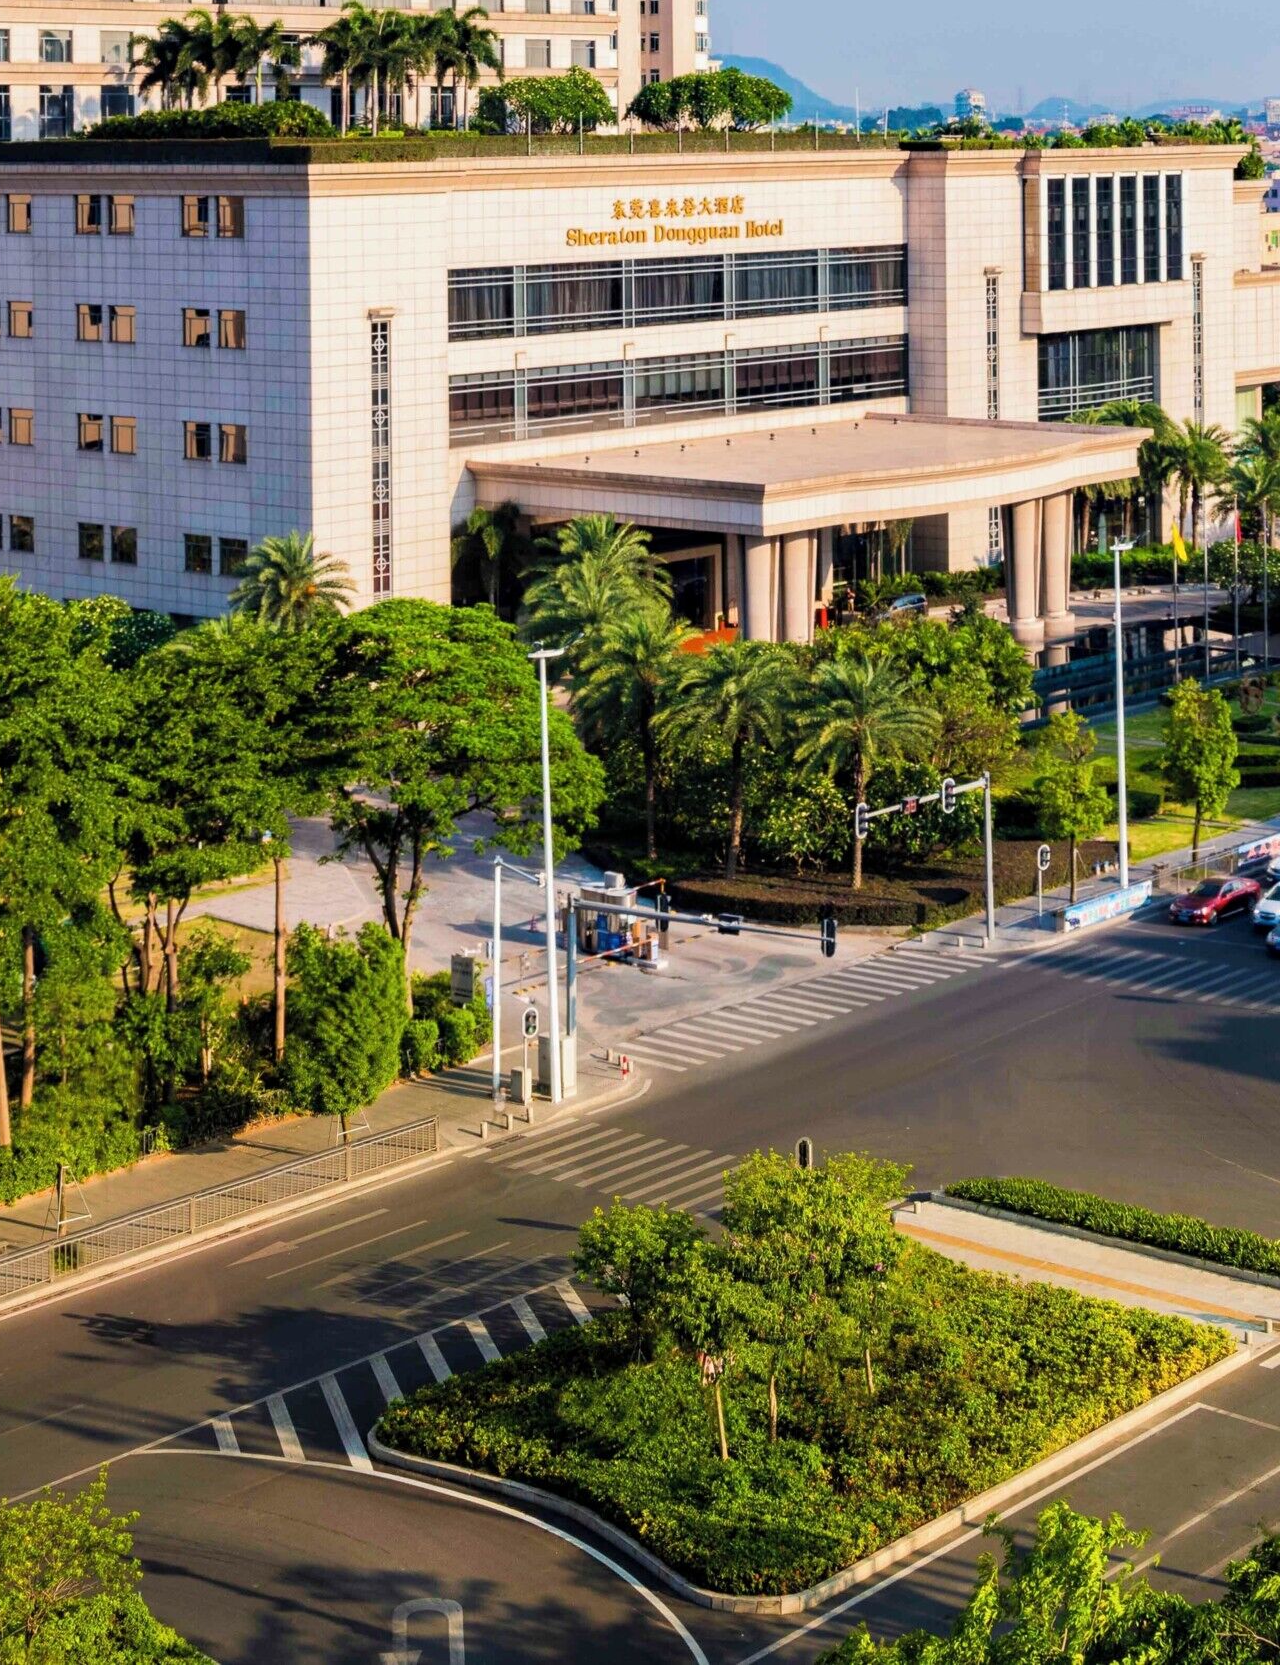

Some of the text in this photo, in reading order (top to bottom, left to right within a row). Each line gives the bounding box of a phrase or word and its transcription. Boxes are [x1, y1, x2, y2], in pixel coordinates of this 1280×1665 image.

[610, 194, 746, 220] 东莞喜来登大酒店
[566, 219, 784, 247] Sheraton Dongguan Hotel
